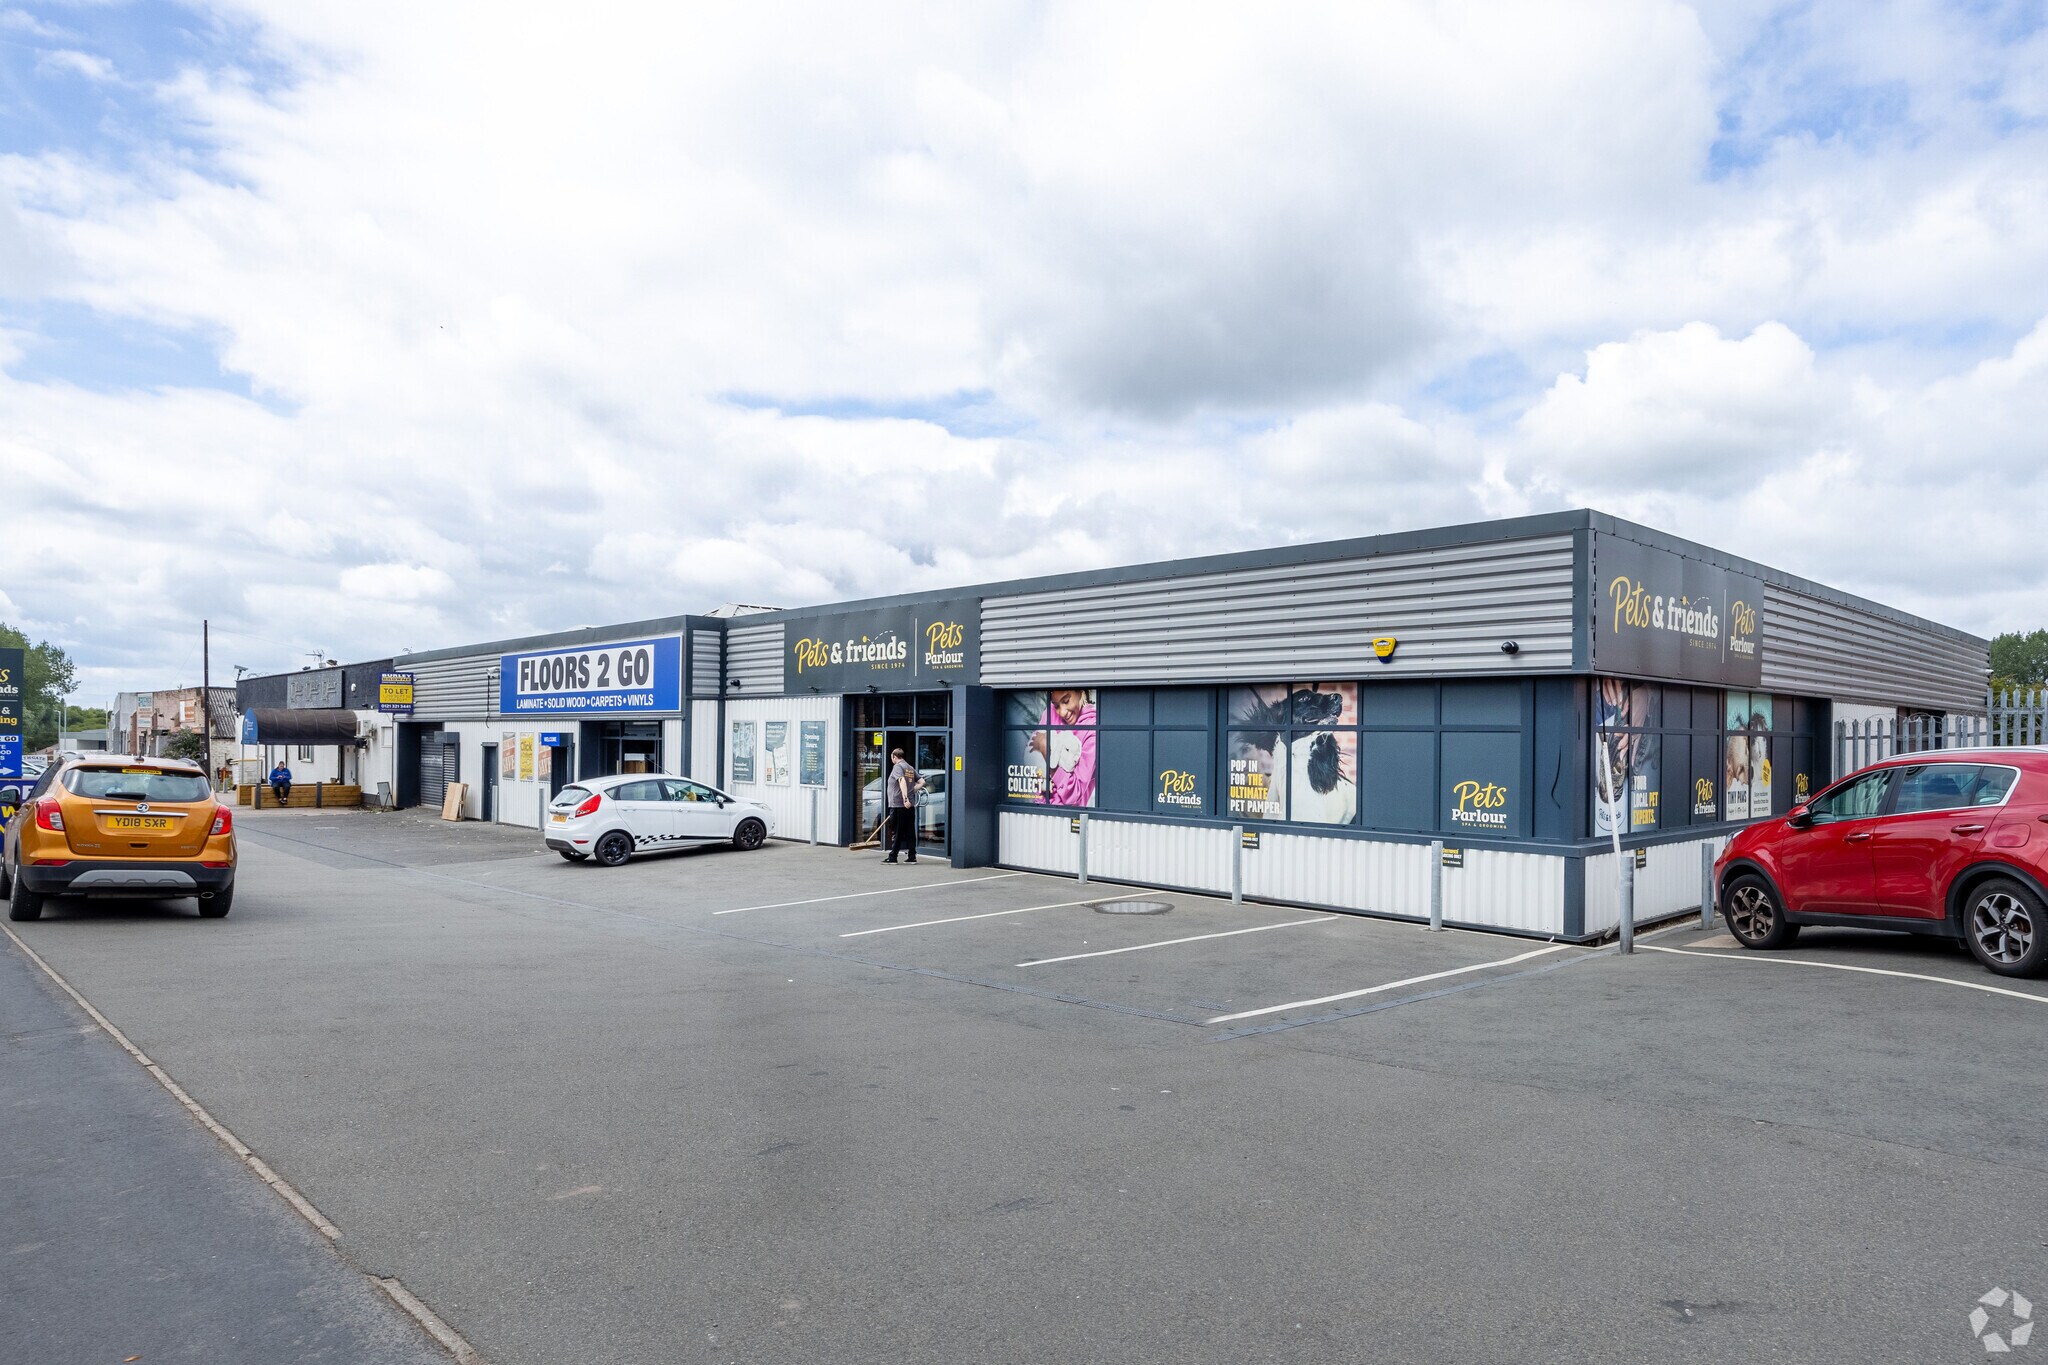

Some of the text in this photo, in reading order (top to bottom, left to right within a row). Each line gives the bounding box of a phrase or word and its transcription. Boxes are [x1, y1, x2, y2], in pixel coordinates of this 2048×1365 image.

[1609, 576, 1719, 639] Pets & friends
[1731, 600, 1756, 641] Pets
[926, 621, 964, 656] Pets
[1730, 636, 1755, 654] Parlour
[794, 635, 907, 674] Pets & friends
[925, 650, 964, 665] Parlour
[520, 648, 649, 692] FLOORS 2 GO
[891, 661, 905, 669] 1974
[516, 693, 654, 709] LAMINATE SOLID WOOD CARPETS VINYLS
[1008, 765, 1038, 778] CLICK
[1230, 759, 1258, 773] POP IN
[1007, 777, 1043, 794] COLLECT
[1160, 769, 1196, 797] Pets
[1230, 772, 1264, 786] FOR THE
[1796, 773, 1809, 796] Pets
[1157, 791, 1202, 806] & friends
[1230, 786, 1269, 800] ULTIMATE
[1453, 780, 1507, 813] Pets
[1633, 791, 1659, 808] LOCAL PET
[1695, 778, 1713, 807] Pets
[1230, 799, 1283, 815] PET PAMPER.
[1694, 803, 1699, 815] &
[1699, 802, 1716, 814] friends
[115, 817, 167, 828] YD18 SXR
[1451, 808, 1508, 824] Parlour
[1478, 822, 1507, 830] GROOMING
